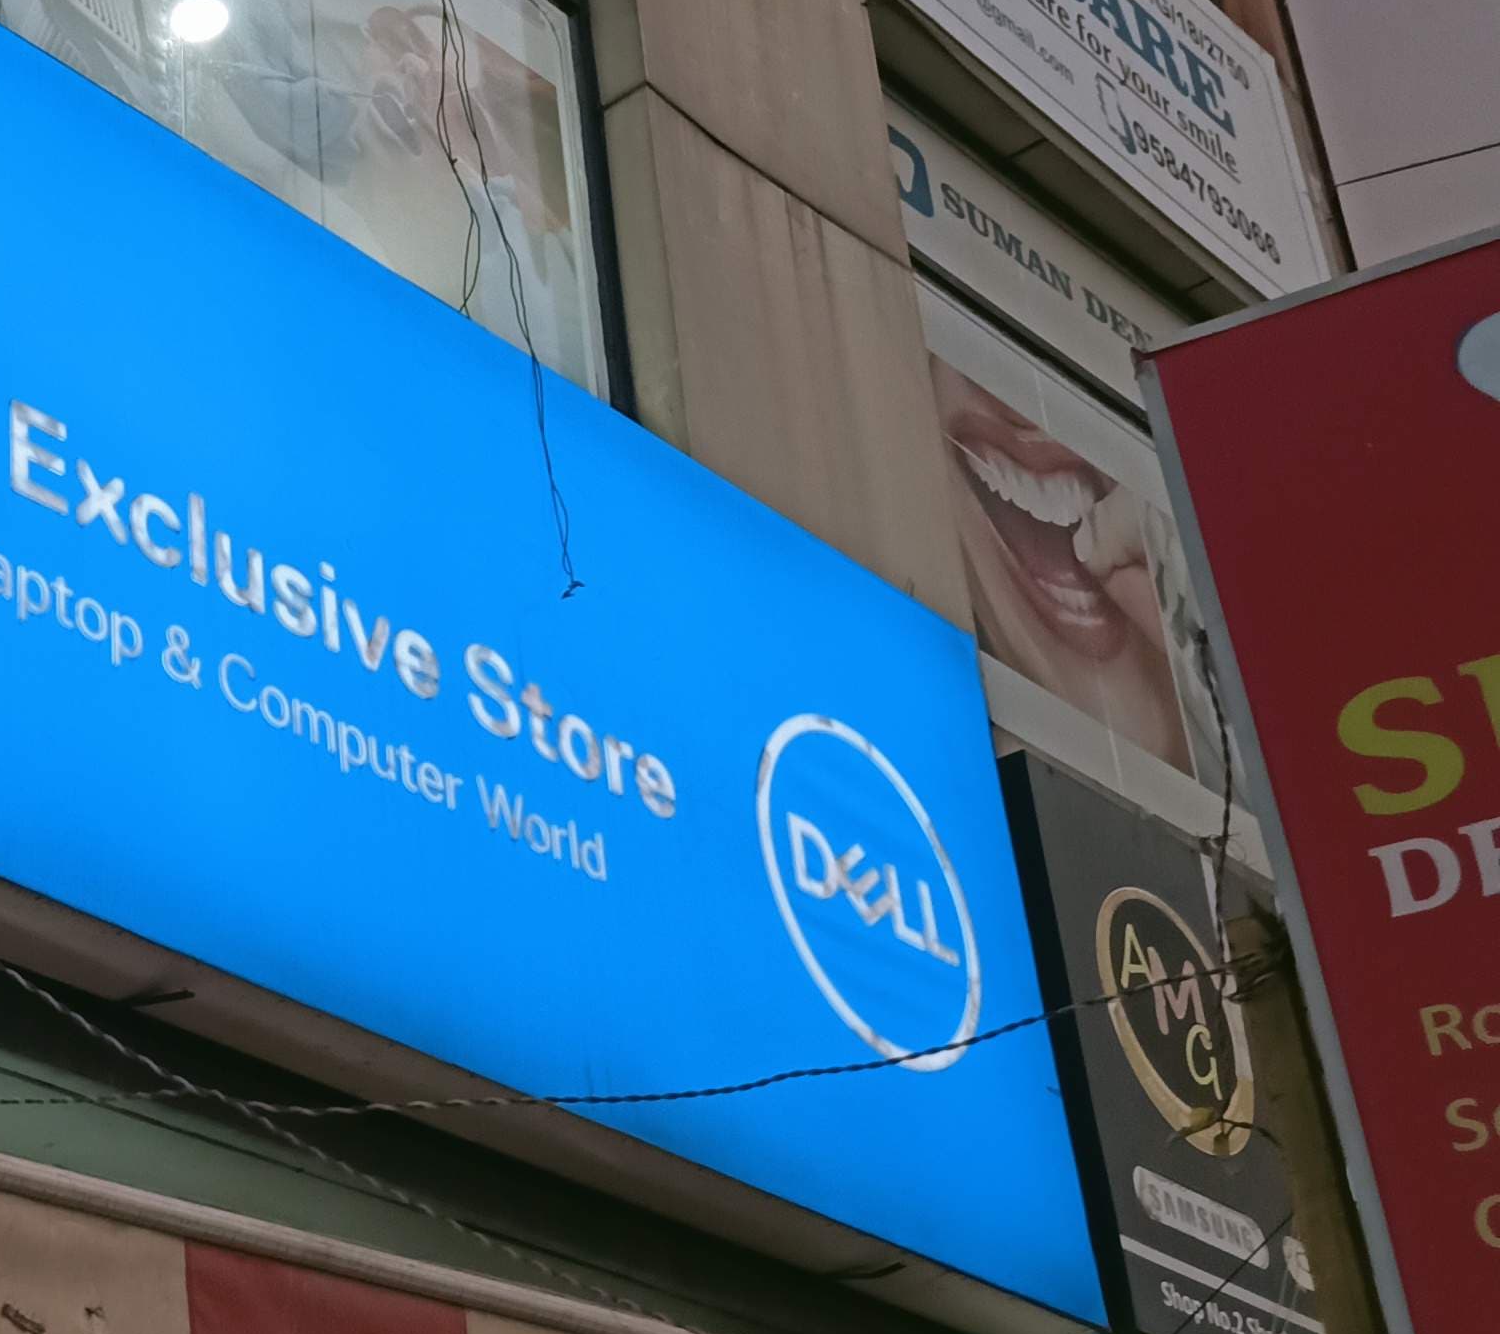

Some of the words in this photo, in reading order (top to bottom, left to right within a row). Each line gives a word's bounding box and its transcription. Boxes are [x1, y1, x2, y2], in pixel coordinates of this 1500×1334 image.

[1076, 13, 1112, 64] for
[1118, 56, 1170, 113] your
[1177, 110, 1237, 174] smile
[940, 182, 1073, 301] SUMAN
[8, 398, 441, 700] Exclusive
[463, 642, 677, 819] Store
[160, 624, 202, 689] &
[217, 652, 463, 812] Computer
[475, 773, 608, 884] World
[787, 811, 960, 968] DELL
